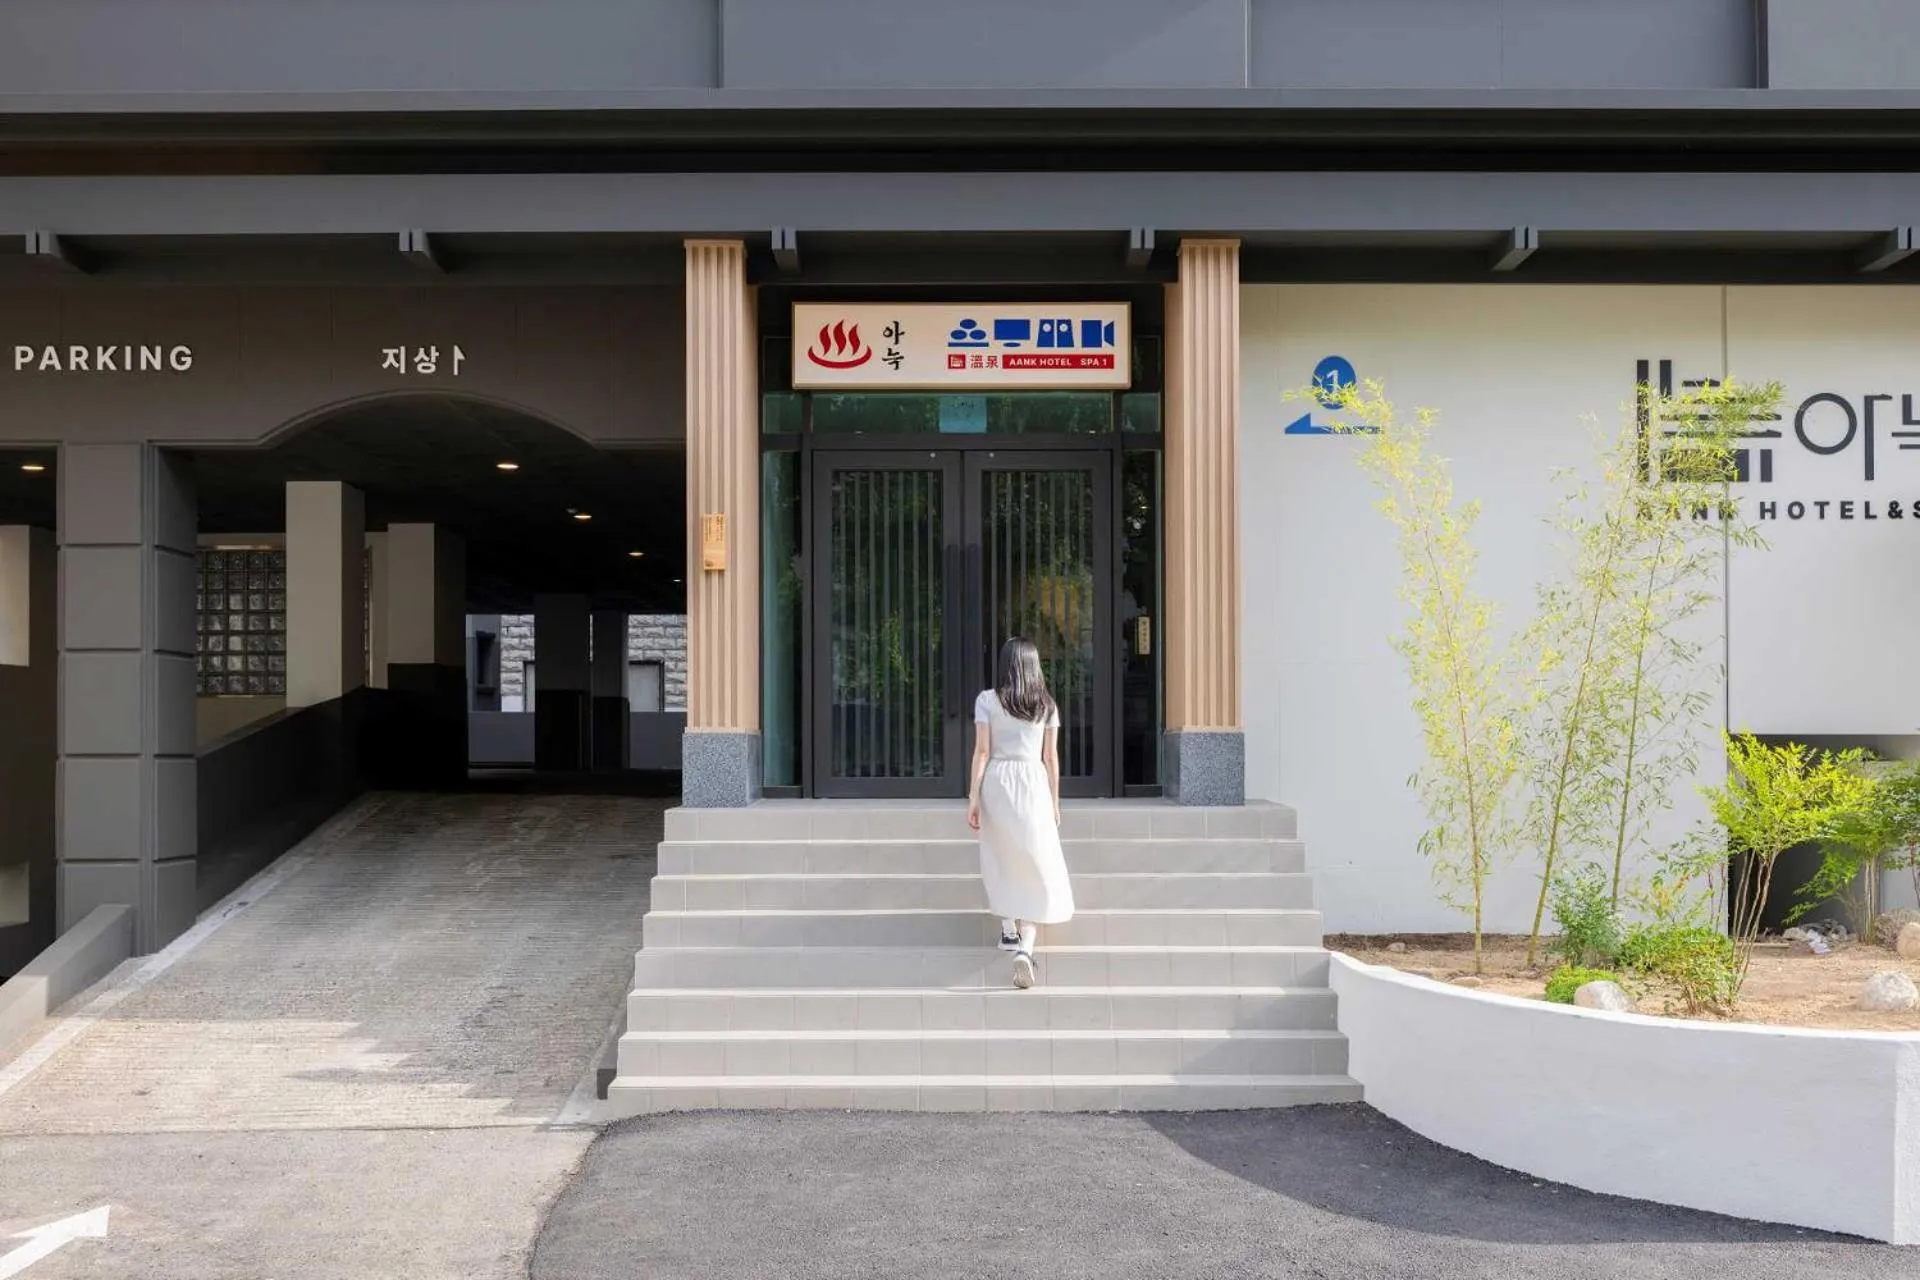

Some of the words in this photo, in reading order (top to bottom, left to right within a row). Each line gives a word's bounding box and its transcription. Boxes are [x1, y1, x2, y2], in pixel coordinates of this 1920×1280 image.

[14, 345, 193, 371] PARKING
[881, 320, 905, 371] 아늑
[381, 345, 440, 374] 지상
[1009, 358, 1037, 366] AANK
[1039, 358, 1072, 366] HOTEL
[1080, 358, 1100, 366] SPA
[1326, 369, 1339, 395] 1
